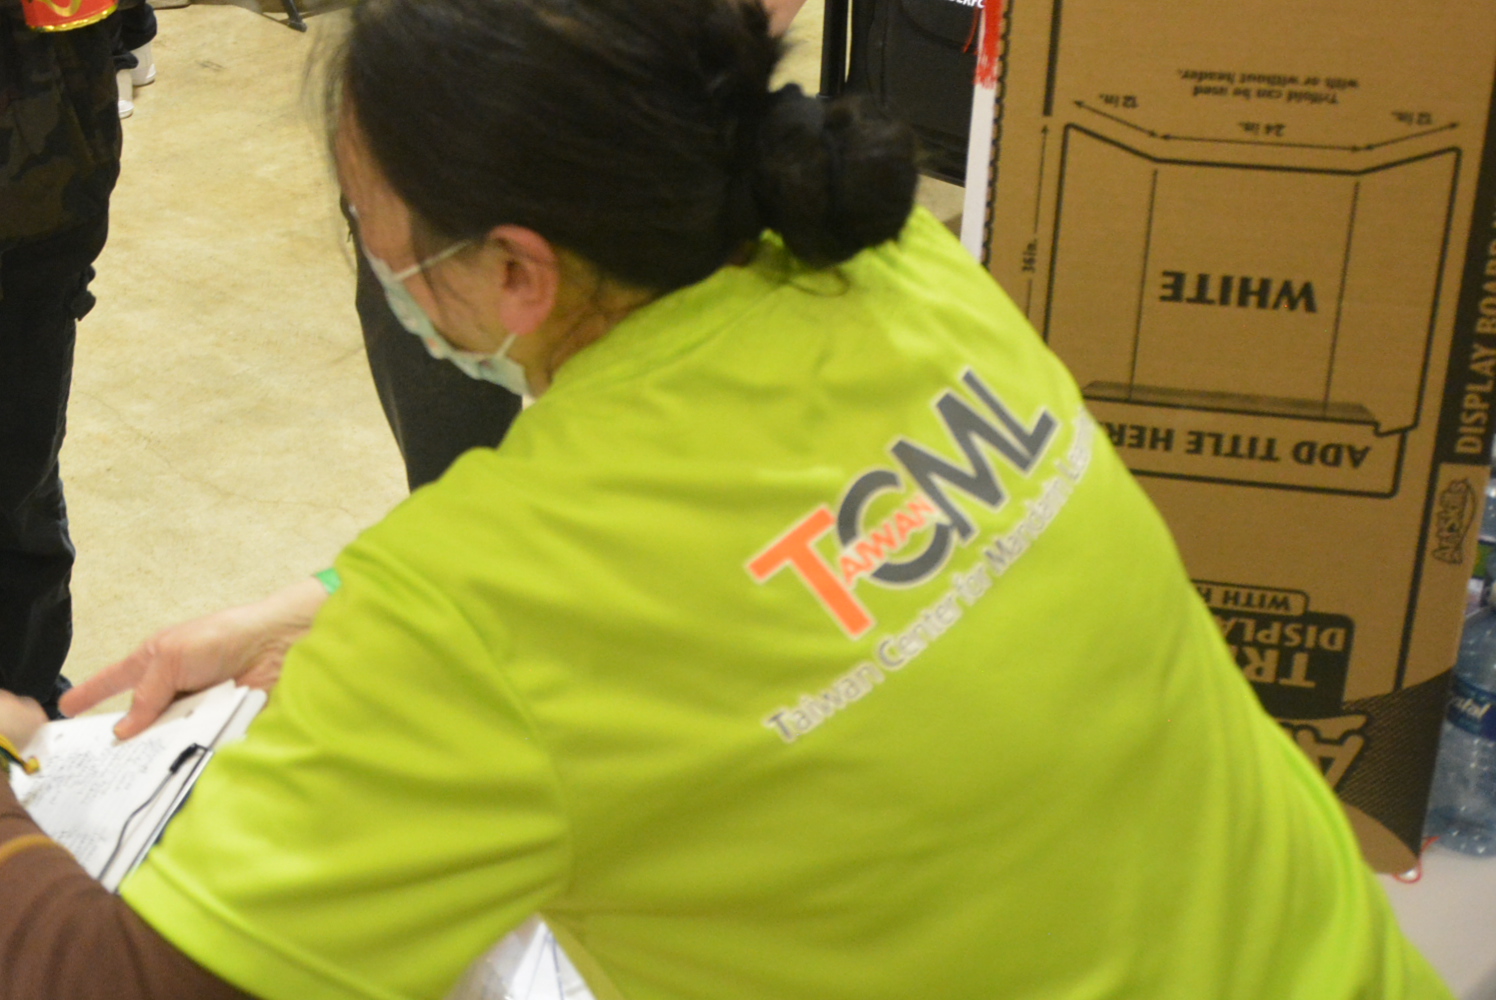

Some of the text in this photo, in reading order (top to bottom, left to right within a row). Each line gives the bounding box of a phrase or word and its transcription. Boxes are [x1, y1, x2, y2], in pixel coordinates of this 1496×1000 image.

[1239, 72, 1298, 88] without
[1300, 77, 1321, 88] or
[1325, 76, 1360, 90] with
[1193, 84, 1224, 98] used
[1229, 86, 1252, 100] be
[1256, 87, 1284, 100] can
[1098, 92, 1139, 109] 12 in.
[1391, 110, 1433, 125] 12 in.
[1238, 121, 1286, 137] 24 in.
[1159, 270, 1317, 313] WHITE
[1456, 341, 1496, 455] DISPLAY
[1102, 421, 1371, 469] ADD TITLE HER
[746, 366, 1061, 640] TCML
[763, 661, 885, 742] Taiwan
[876, 590, 963, 671] Center
[951, 563, 992, 605] for
[984, 474, 1073, 576] Mandarin
[1223, 590, 1292, 612] WITH
[1213, 614, 1347, 652] DISPLA
